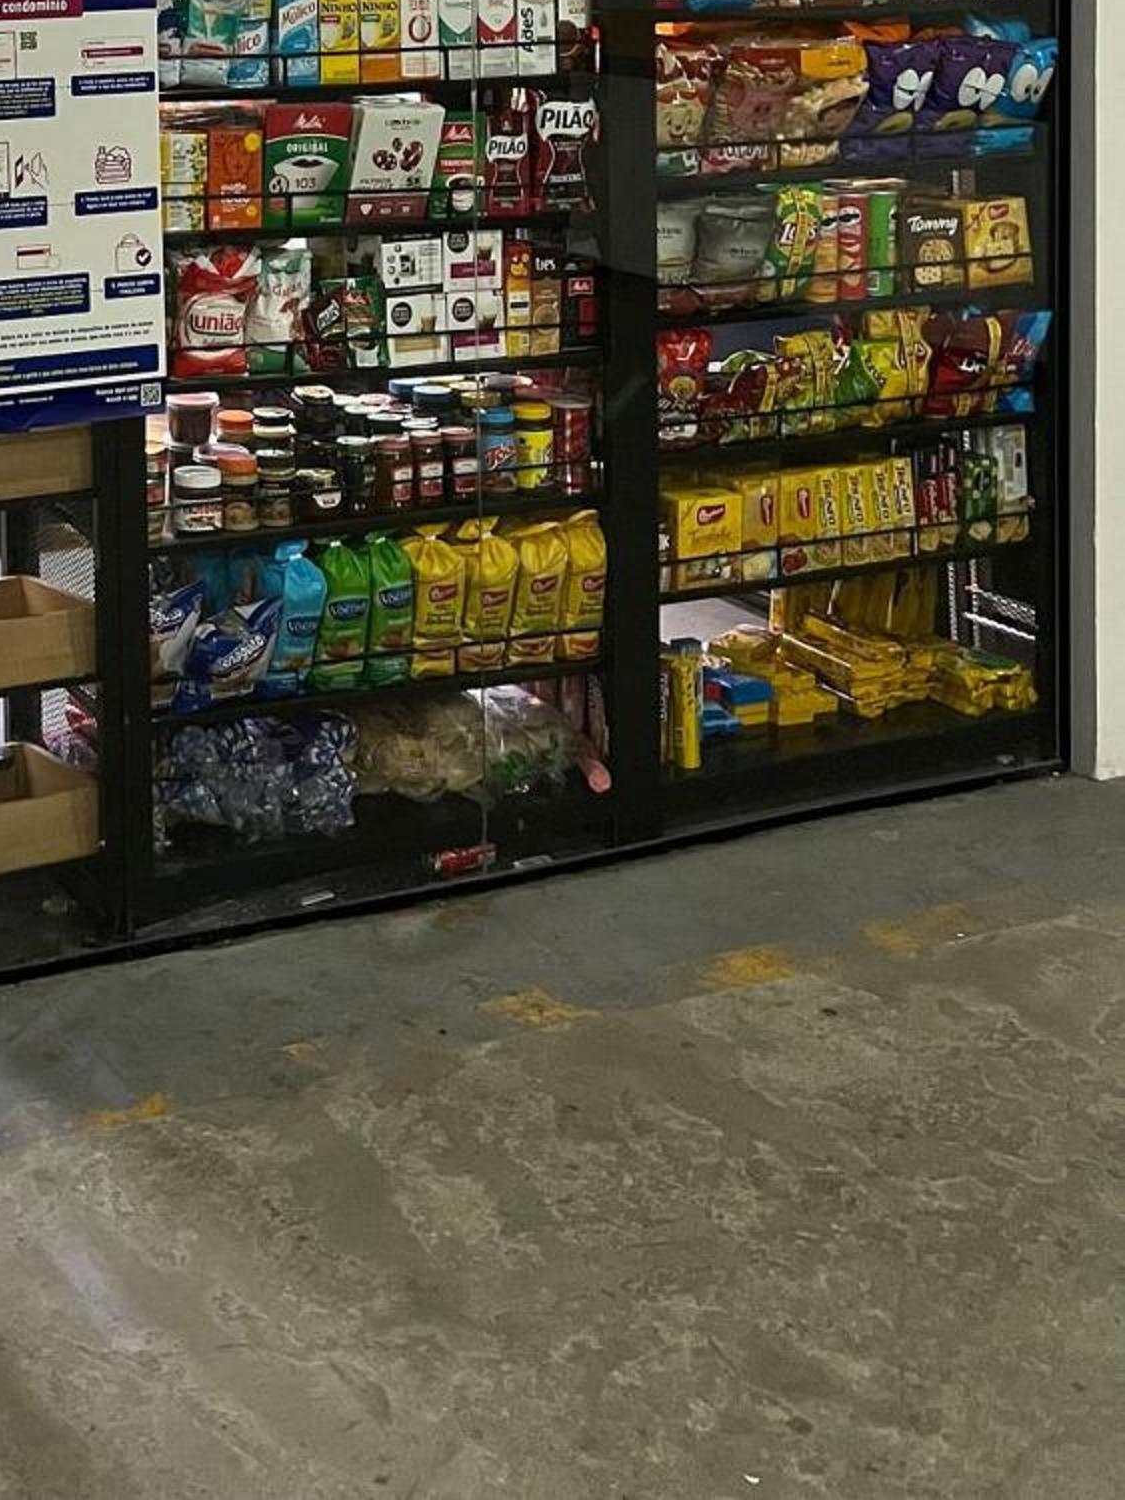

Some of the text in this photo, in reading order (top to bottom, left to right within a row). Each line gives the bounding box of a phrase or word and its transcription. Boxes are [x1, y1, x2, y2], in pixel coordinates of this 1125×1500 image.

[540, 106, 594, 130] PILÃO
[489, 138, 525, 155] PILÃO
[296, 177, 316, 189] 103
[907, 215, 959, 237] Tommy
[193, 314, 243, 333] união
